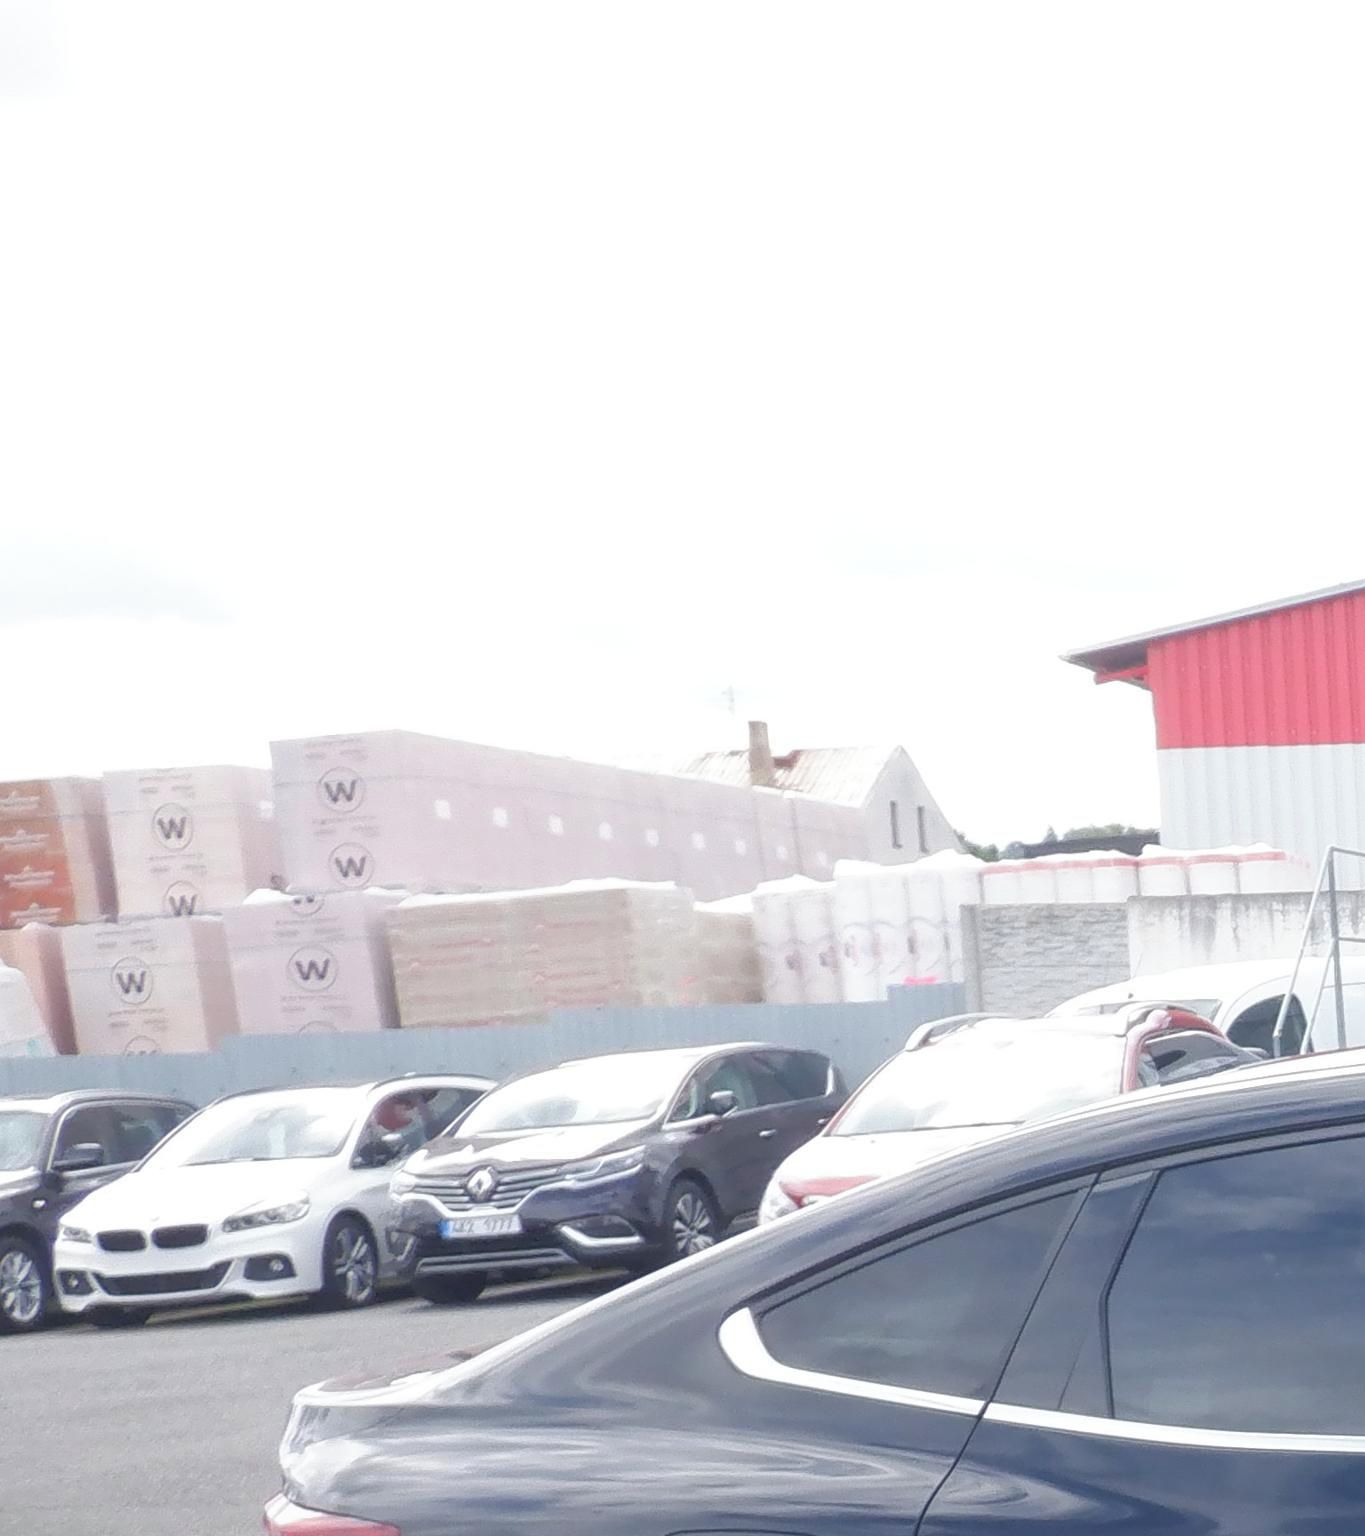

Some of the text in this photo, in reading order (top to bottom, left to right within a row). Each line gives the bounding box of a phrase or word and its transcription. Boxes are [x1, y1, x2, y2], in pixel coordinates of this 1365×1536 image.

[324, 780, 357, 804] W
[158, 816, 187, 840] W
[336, 857, 366, 878] W
[295, 958, 331, 981] W
[116, 970, 146, 994] W
